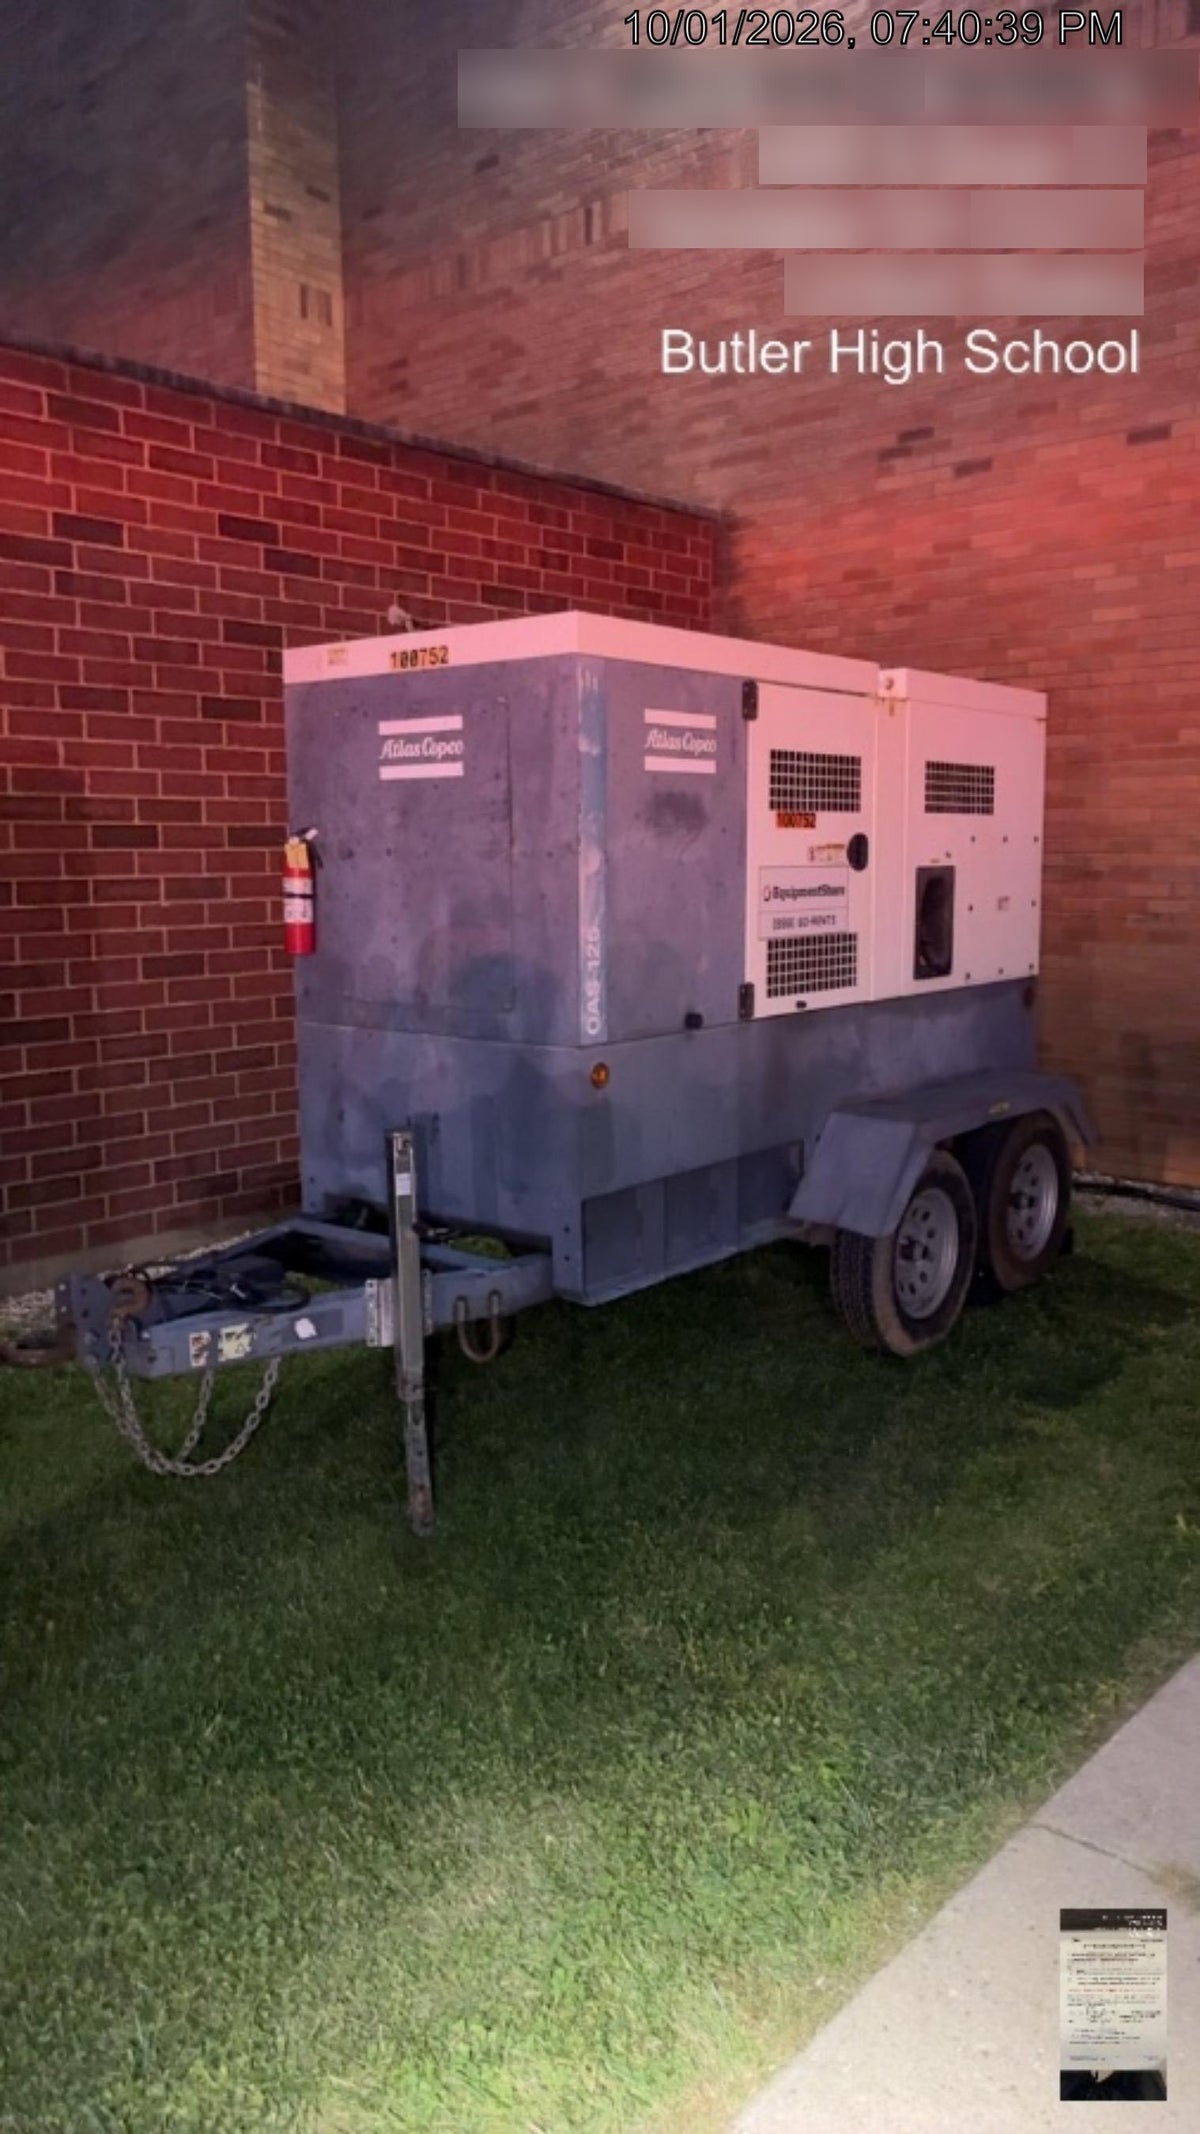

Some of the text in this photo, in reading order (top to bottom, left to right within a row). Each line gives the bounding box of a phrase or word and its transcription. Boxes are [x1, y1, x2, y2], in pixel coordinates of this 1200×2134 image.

[390, 645, 449, 669] 100752
[379, 736, 465, 760] Atlas Copco
[644, 728, 717, 757] Atlas Copco
